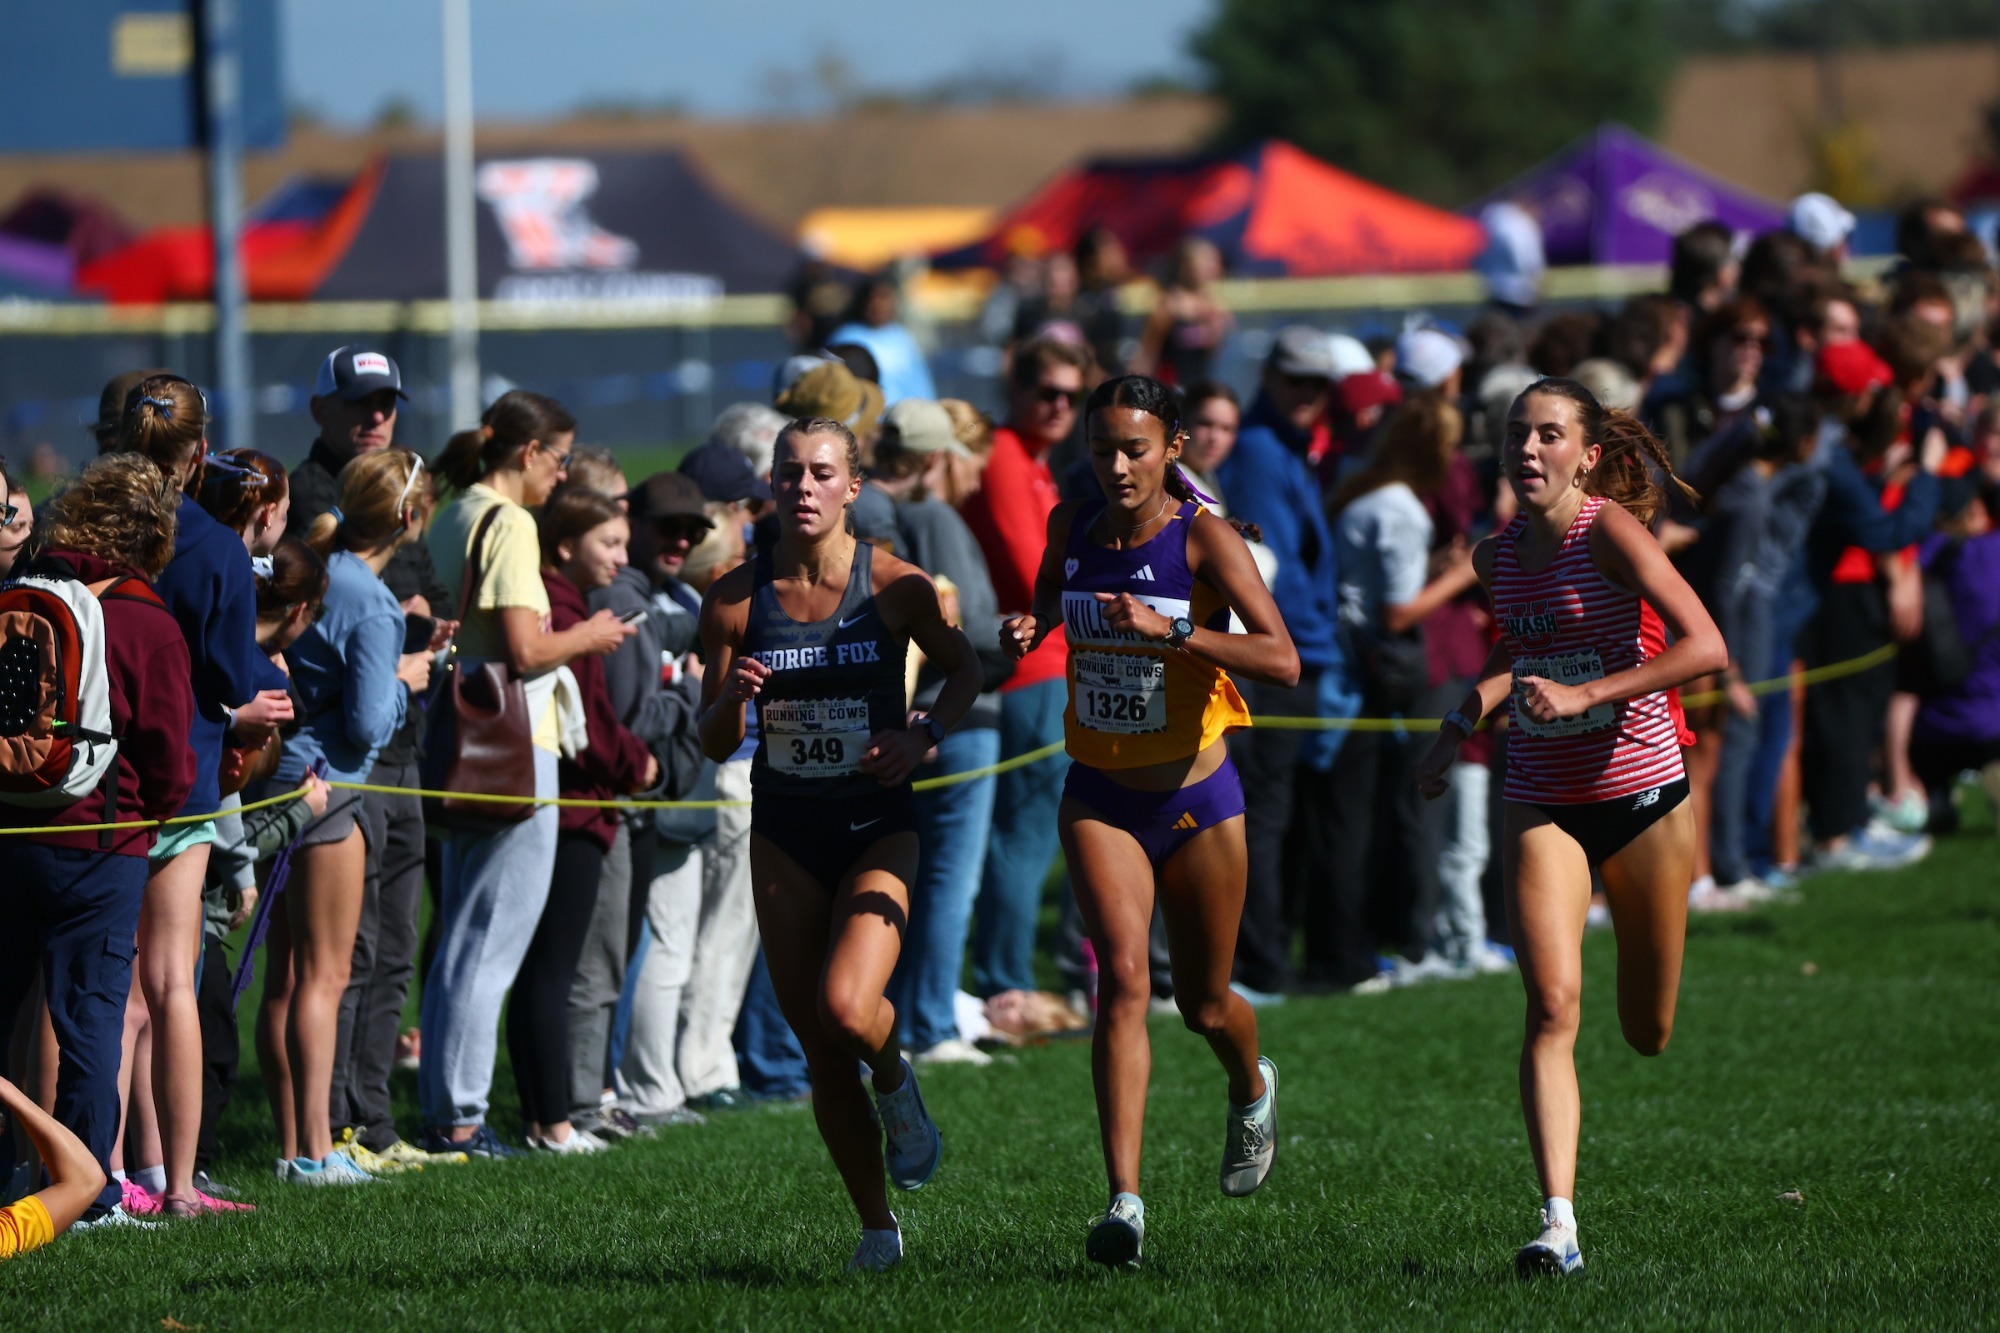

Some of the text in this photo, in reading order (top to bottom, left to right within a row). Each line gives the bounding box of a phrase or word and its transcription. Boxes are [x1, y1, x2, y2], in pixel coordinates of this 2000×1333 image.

[1504, 611, 1560, 638] WASH
[835, 640, 881, 665] FOX
[1075, 658, 1114, 675] RUNNING
[1126, 665, 1162, 678] COWS
[1562, 659, 1601, 677] COWS
[766, 706, 866, 721] RUNNING COWS
[818, 701, 847, 709] COLLEGE
[1087, 690, 1147, 722] 1326
[791, 737, 844, 765] 349
